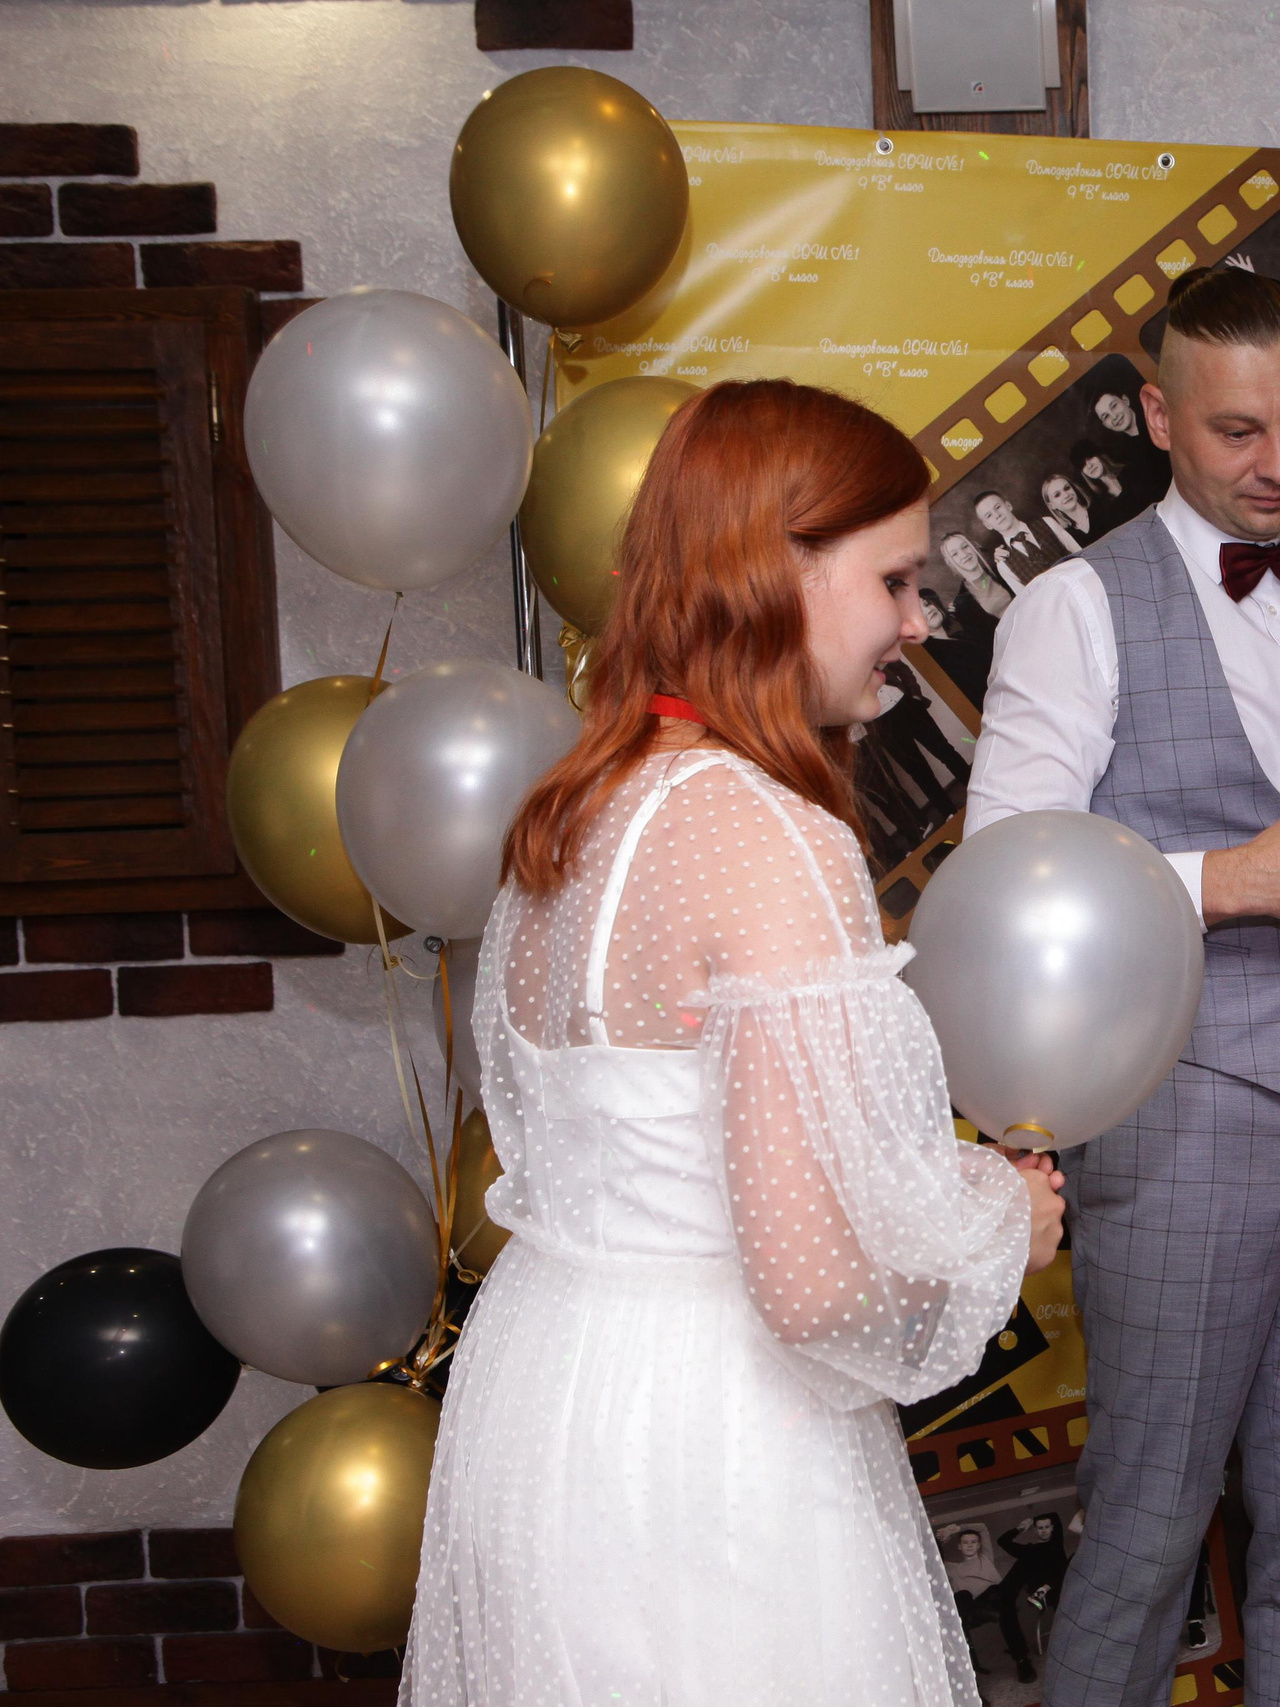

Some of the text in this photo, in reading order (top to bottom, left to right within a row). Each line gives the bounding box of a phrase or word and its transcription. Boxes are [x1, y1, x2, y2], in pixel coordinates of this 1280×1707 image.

[897, 153, 933, 171] СОШ
[1105, 163, 1139, 180] СОШ
[792, 243, 828, 261] СОШ
[1008, 250, 1043, 267] СОШ
[902, 339, 938, 356] СОШ
